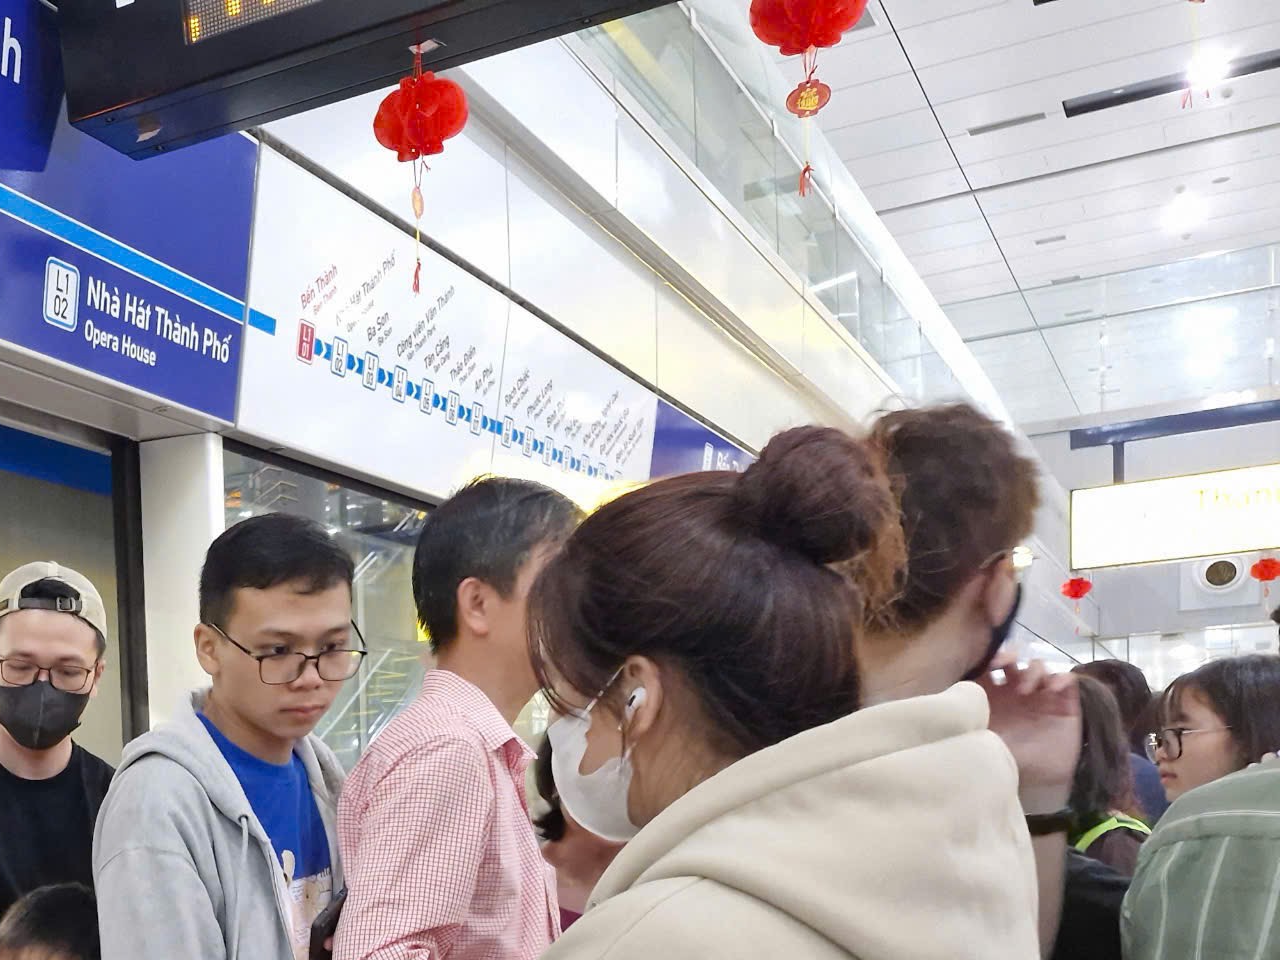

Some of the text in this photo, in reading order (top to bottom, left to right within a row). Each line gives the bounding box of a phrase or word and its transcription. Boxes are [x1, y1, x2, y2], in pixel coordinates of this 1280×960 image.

[55, 269, 70, 295] L1
[53, 295, 69, 320] 02
[86, 276, 233, 364] Nhà Hát Thành Phố
[376, 312, 389, 332] Son
[84, 319, 157, 367] Opera House
